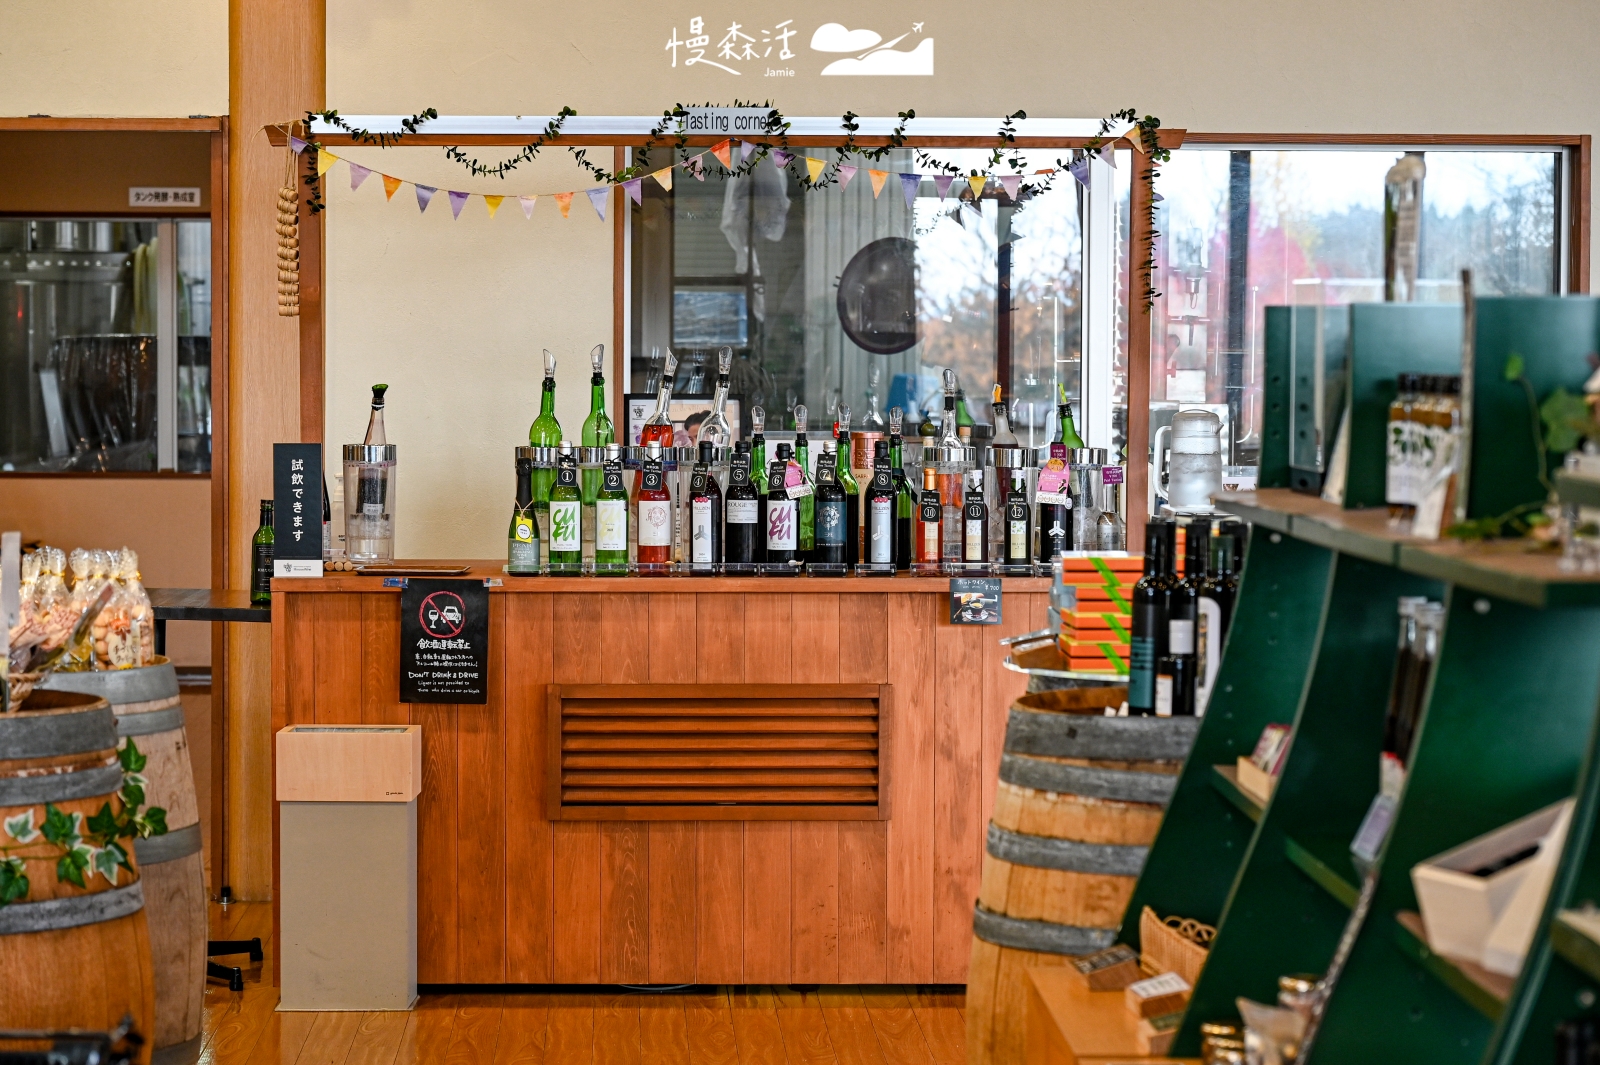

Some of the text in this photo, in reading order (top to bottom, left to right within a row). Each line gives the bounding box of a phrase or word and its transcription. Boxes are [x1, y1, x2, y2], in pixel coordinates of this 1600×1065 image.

[291, 459, 304, 541] 試飲できます
[417, 638, 471, 650] 飲酒運転禁止
[458, 671, 479, 679] DRIVE
